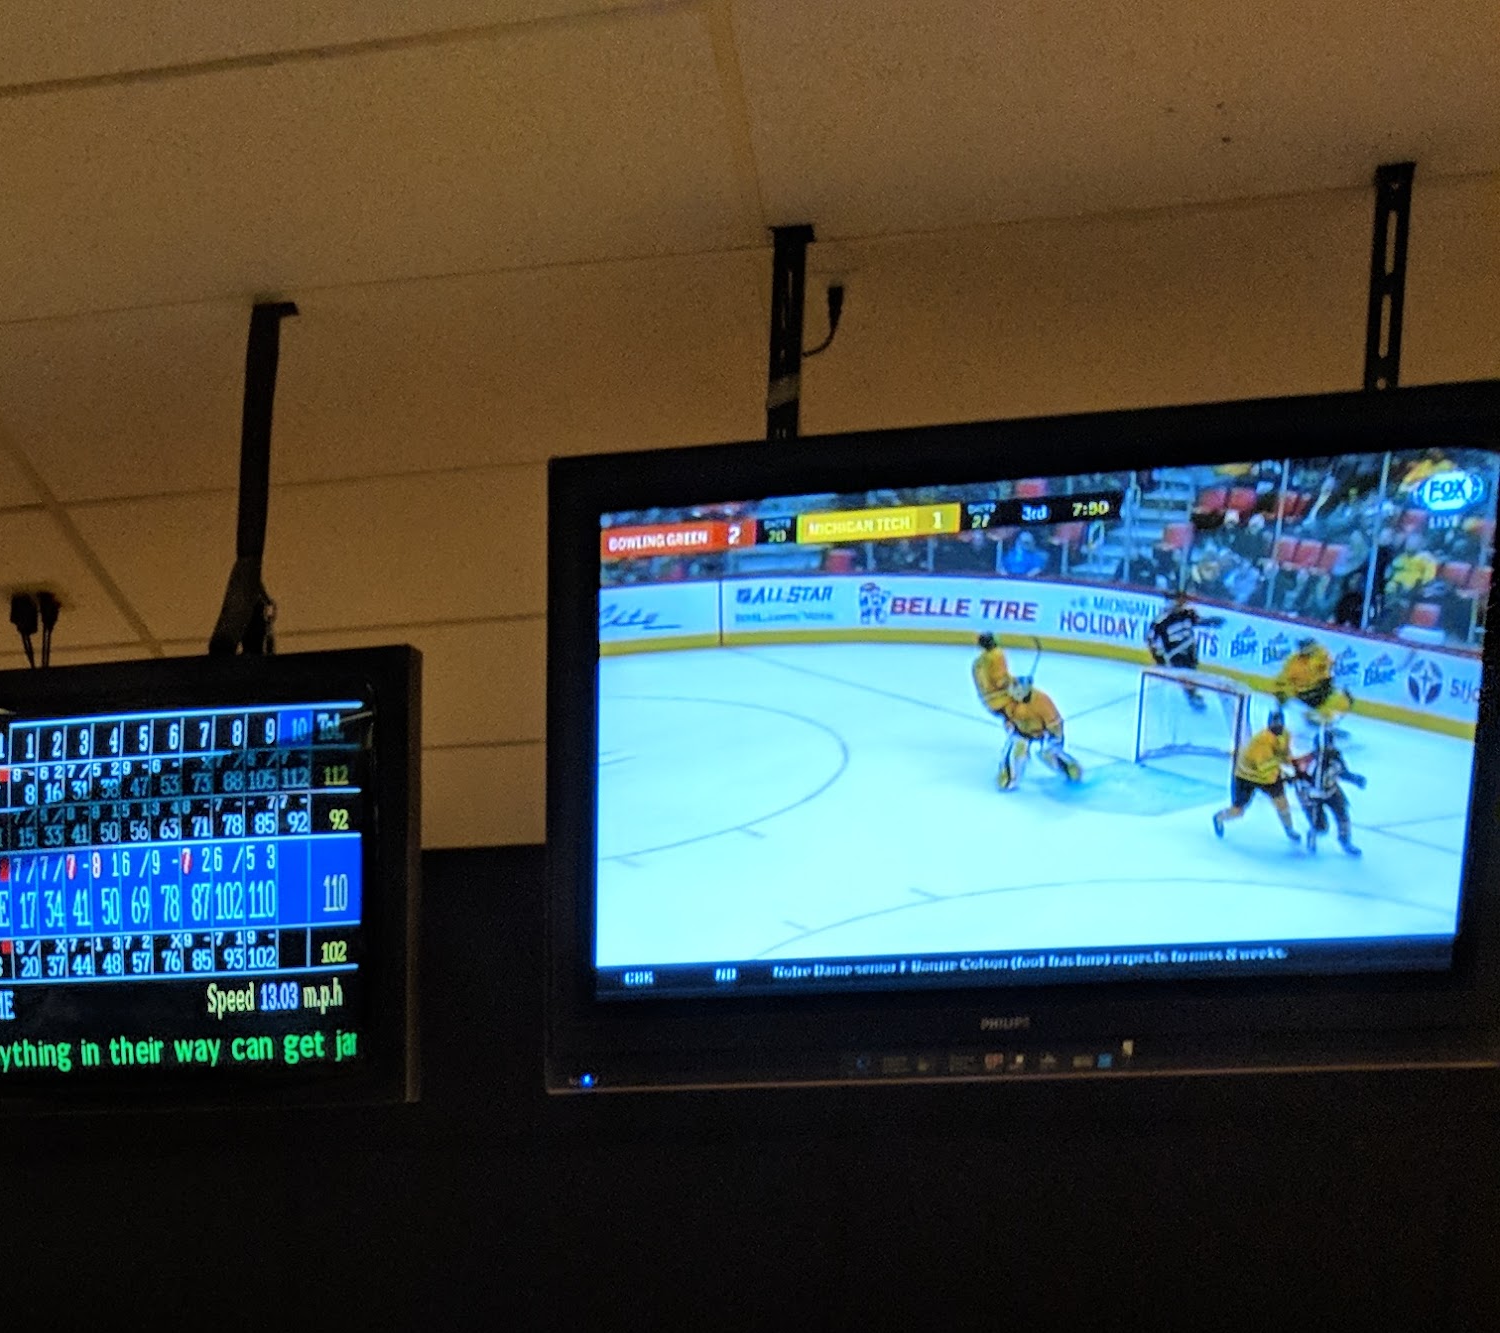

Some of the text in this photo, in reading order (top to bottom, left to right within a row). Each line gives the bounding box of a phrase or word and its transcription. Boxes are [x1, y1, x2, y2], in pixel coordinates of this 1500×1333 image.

[1430, 480, 1466, 501] FOX
[727, 524, 741, 546] 2
[932, 511, 943, 530] 1
[1021, 505, 1047, 521] 3rd
[890, 597, 1038, 622] BELLE TIRE
[1060, 611, 1139, 640] HOLIDAY
[26, 733, 34, 759] 1
[52, 731, 62, 757] 2
[79, 729, 89, 755] 3
[109, 727, 118, 753] 4
[139, 725, 149, 751] 5
[168, 723, 179, 750] 6
[199, 722, 210, 748] 7
[232, 720, 243, 746] 8
[265, 718, 276, 744] 9
[24, 784, 36, 805] 8
[44, 783, 63, 804] 16
[71, 779, 90, 799] 31
[329, 809, 349, 830] 92
[20, 892, 36, 929] 17
[44, 891, 64, 928] 34
[73, 889, 91, 927] 41
[101, 888, 120, 925] 50
[131, 886, 149, 924] 69
[160, 884, 180, 923] 78
[191, 883, 210, 921] 87
[215, 881, 244, 920] 102
[248, 880, 276, 918] 110
[323, 874, 348, 912] 110
[21, 956, 39, 977] 20
[47, 955, 65, 976] 37
[72, 954, 92, 976] 44
[102, 953, 122, 975] 48
[132, 951, 150, 973] 57
[161, 950, 181, 972] 76
[192, 949, 212, 971] 85
[223, 948, 244, 970] 93
[248, 946, 276, 968] 102
[321, 941, 347, 964] 102
[206, 982, 255, 1020] Speed
[260, 982, 299, 1011] 13.03
[303, 977, 343, 1014] m.p.h
[81, 1039, 100, 1067] in
[109, 1036, 164, 1066] their
[174, 1038, 220, 1067] way
[231, 1036, 273, 1061] can
[283, 1031, 325, 1065] get
